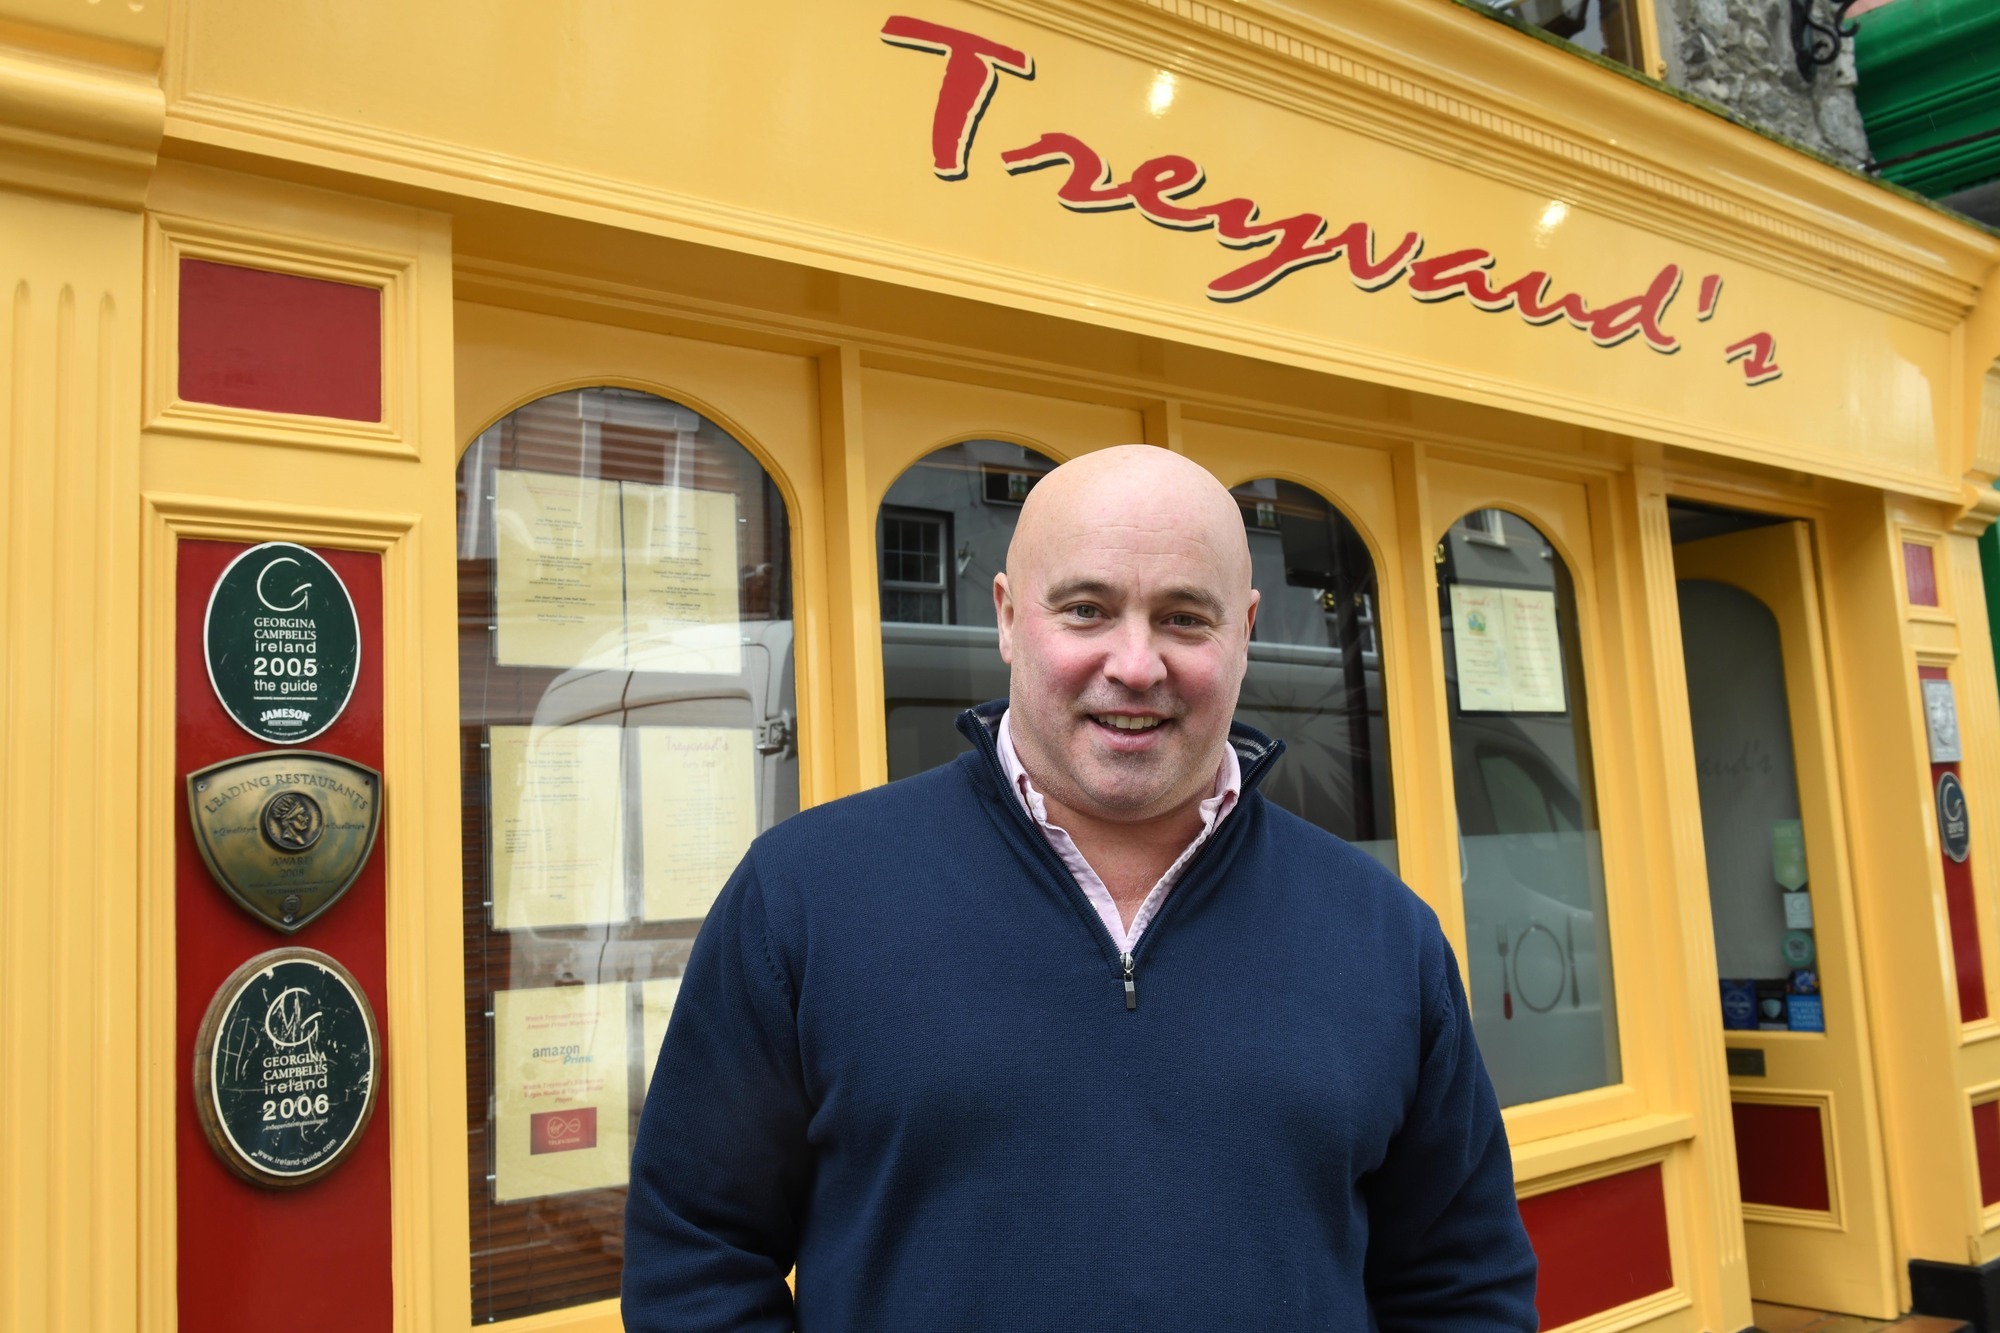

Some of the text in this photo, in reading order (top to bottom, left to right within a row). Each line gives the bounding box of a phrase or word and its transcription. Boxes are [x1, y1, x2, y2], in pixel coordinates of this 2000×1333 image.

[880, 15, 1781, 386] Treyvaud's
[254, 617, 316, 629] GEORGINA
[254, 629, 317, 641] CAMPBELL'S
[255, 640, 316, 654] ireland
[253, 657, 318, 677] 2005
[254, 679, 318, 694] the guide
[260, 708, 311, 722] JAMESON
[205, 773, 368, 815] LEADING RESTAURANTS
[263, 1051, 327, 1068] GEORGINA
[532, 1045, 580, 1058] amazon
[264, 1075, 327, 1095] ireland
[263, 1094, 329, 1121] 2006
[257, 1138, 337, 1166] www.ireland-guide.com
